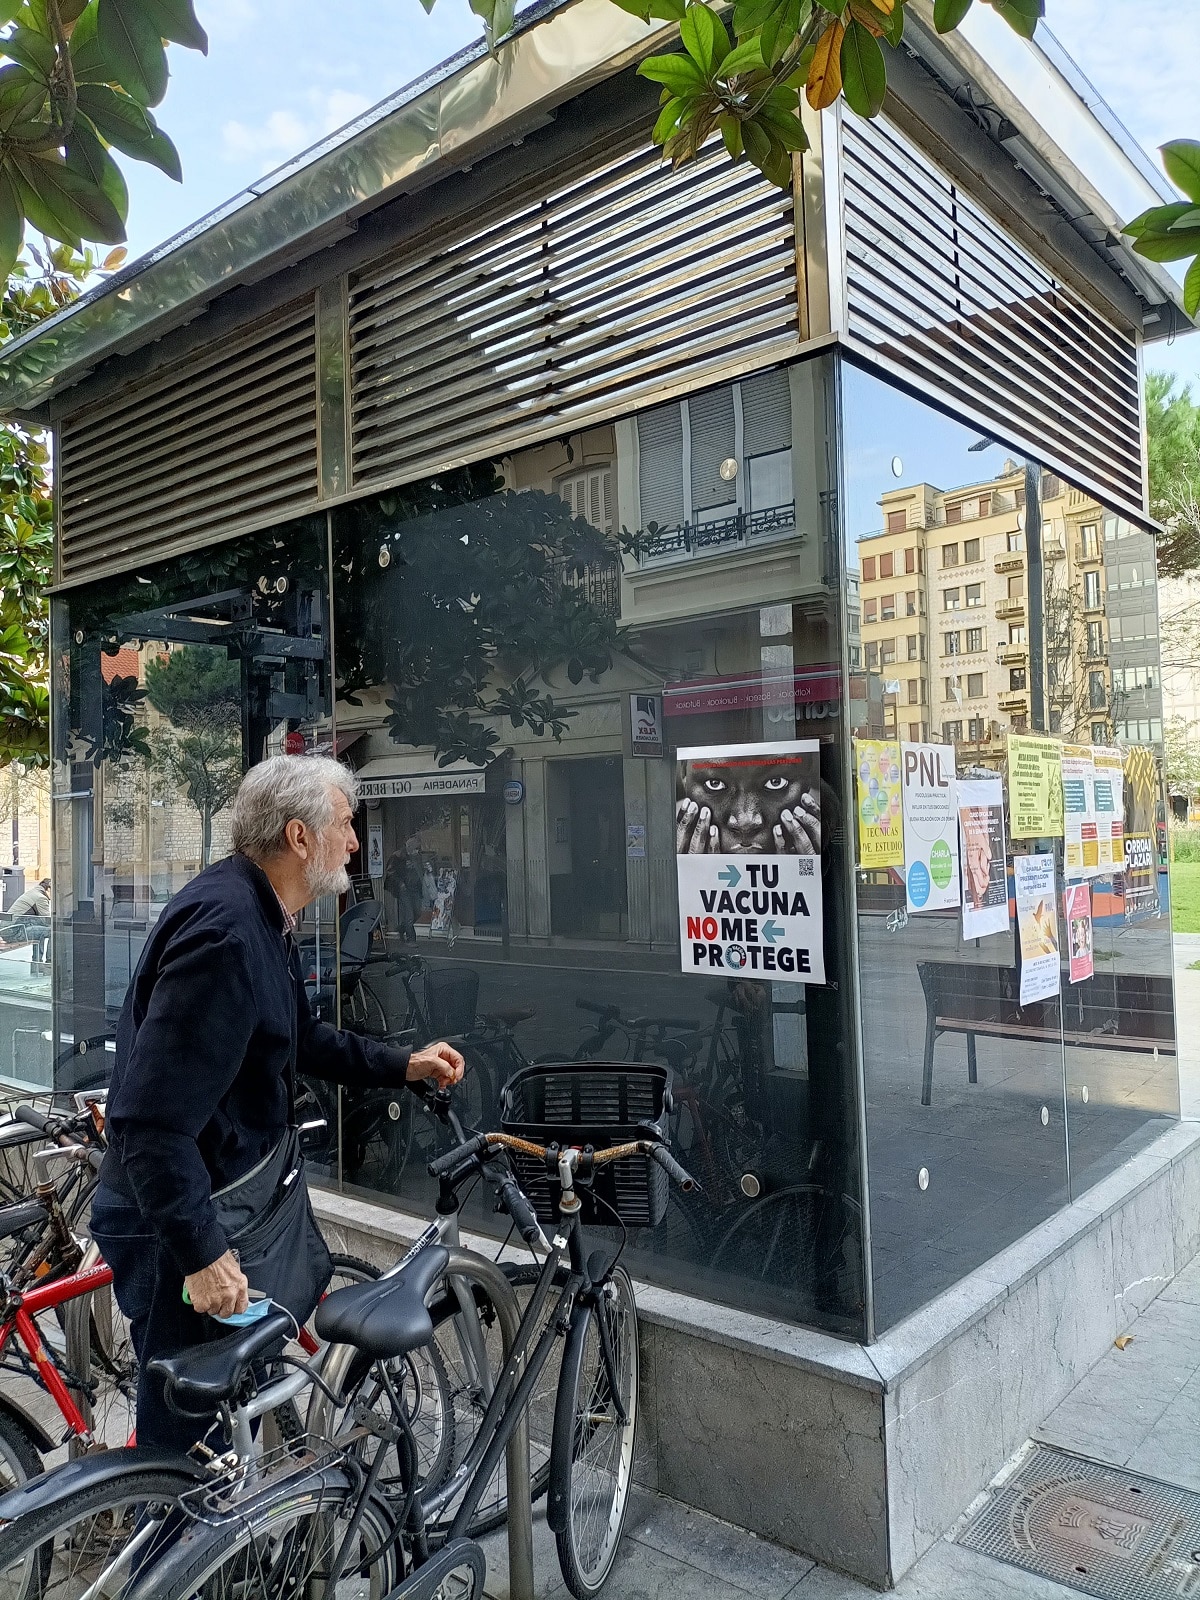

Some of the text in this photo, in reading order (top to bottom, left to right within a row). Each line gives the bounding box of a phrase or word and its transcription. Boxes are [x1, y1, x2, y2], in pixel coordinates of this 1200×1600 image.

[905, 751, 948, 787] PNL
[875, 841, 902, 852] ESTUDIO
[931, 850, 950, 858] CHARLA
[746, 864, 779, 888] TU
[700, 890, 810, 916] VACUNA
[687, 916, 758, 942] NO ME
[693, 943, 811, 973] PROTEGE
